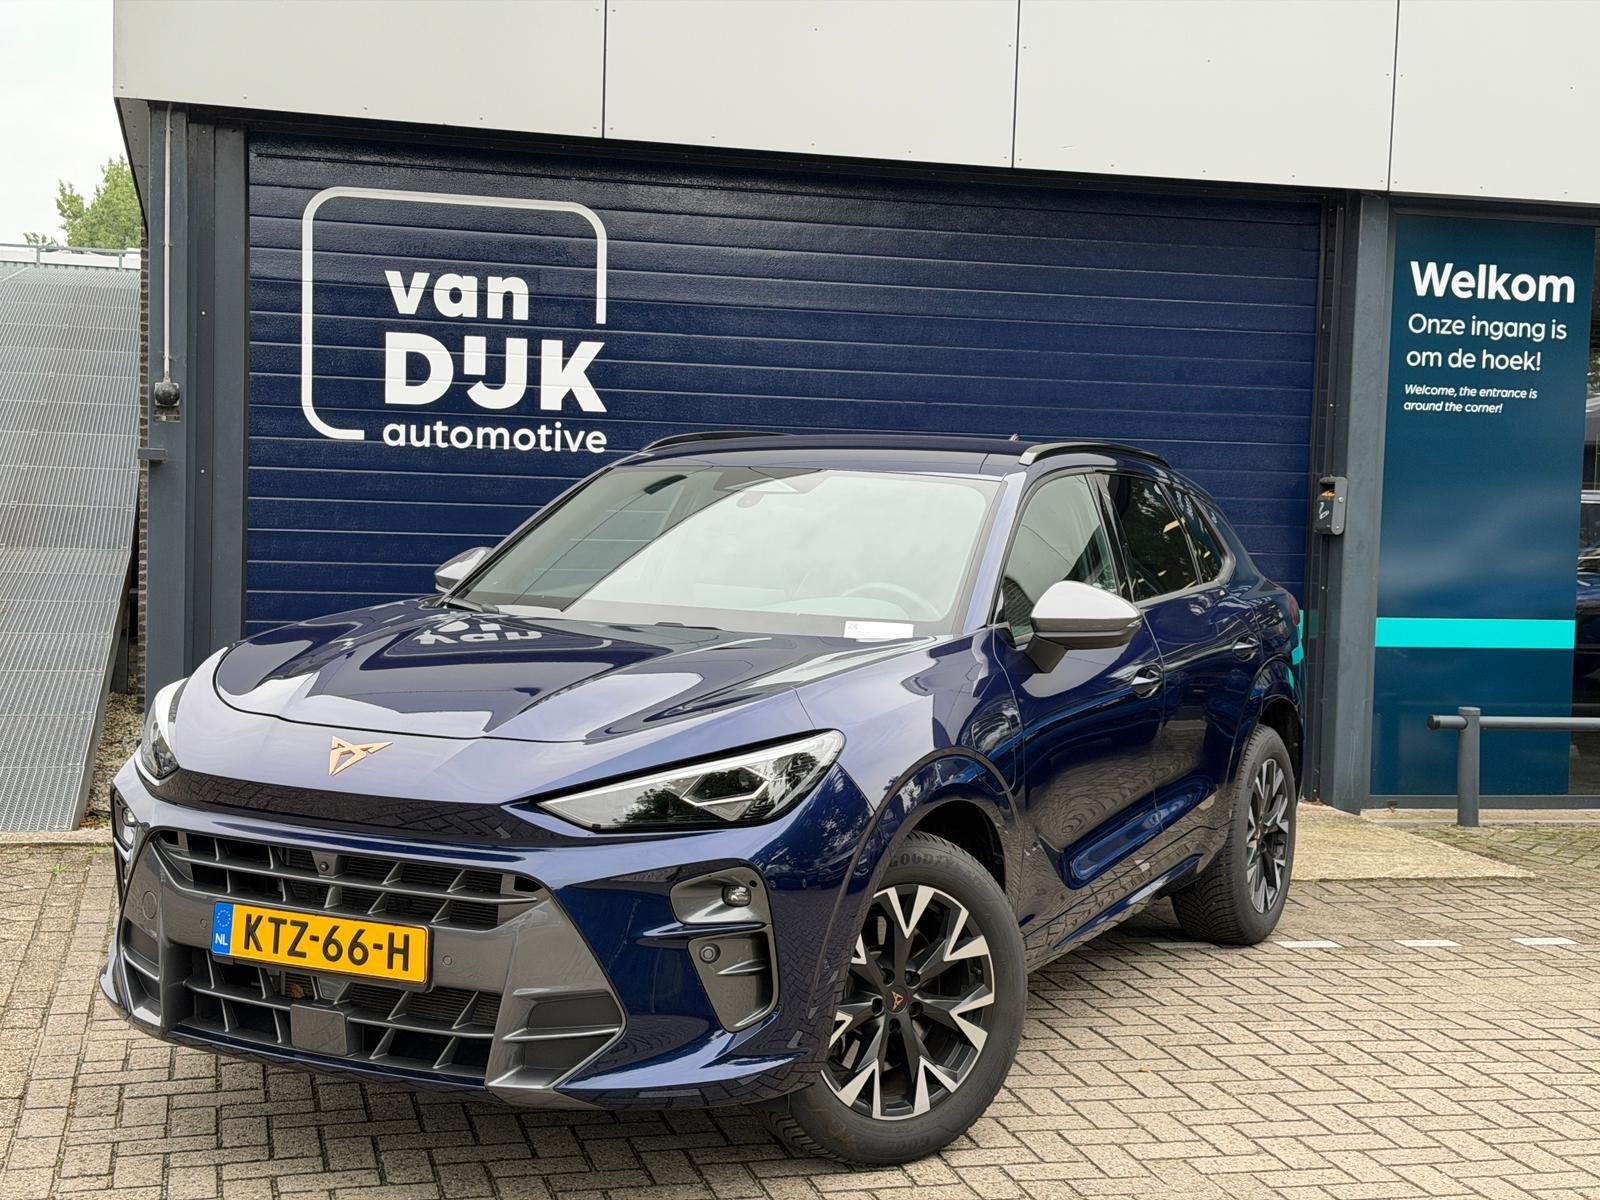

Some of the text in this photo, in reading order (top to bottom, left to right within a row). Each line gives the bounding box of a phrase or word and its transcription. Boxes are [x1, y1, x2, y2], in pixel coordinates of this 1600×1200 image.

[384, 270, 529, 321] van
[1410, 260, 1575, 304] Welkom
[1408, 313, 1568, 343] Onze ingang is
[384, 331, 608, 413] DIJK
[1406, 348, 1542, 371] om de hoek!
[1403, 401, 1503, 413] around the corner!
[1404, 384, 1538, 399] Welcome, the entrance is
[382, 420, 608, 454] automotive
[214, 932, 229, 946] NL
[243, 913, 410, 972] KTZ-66-H
